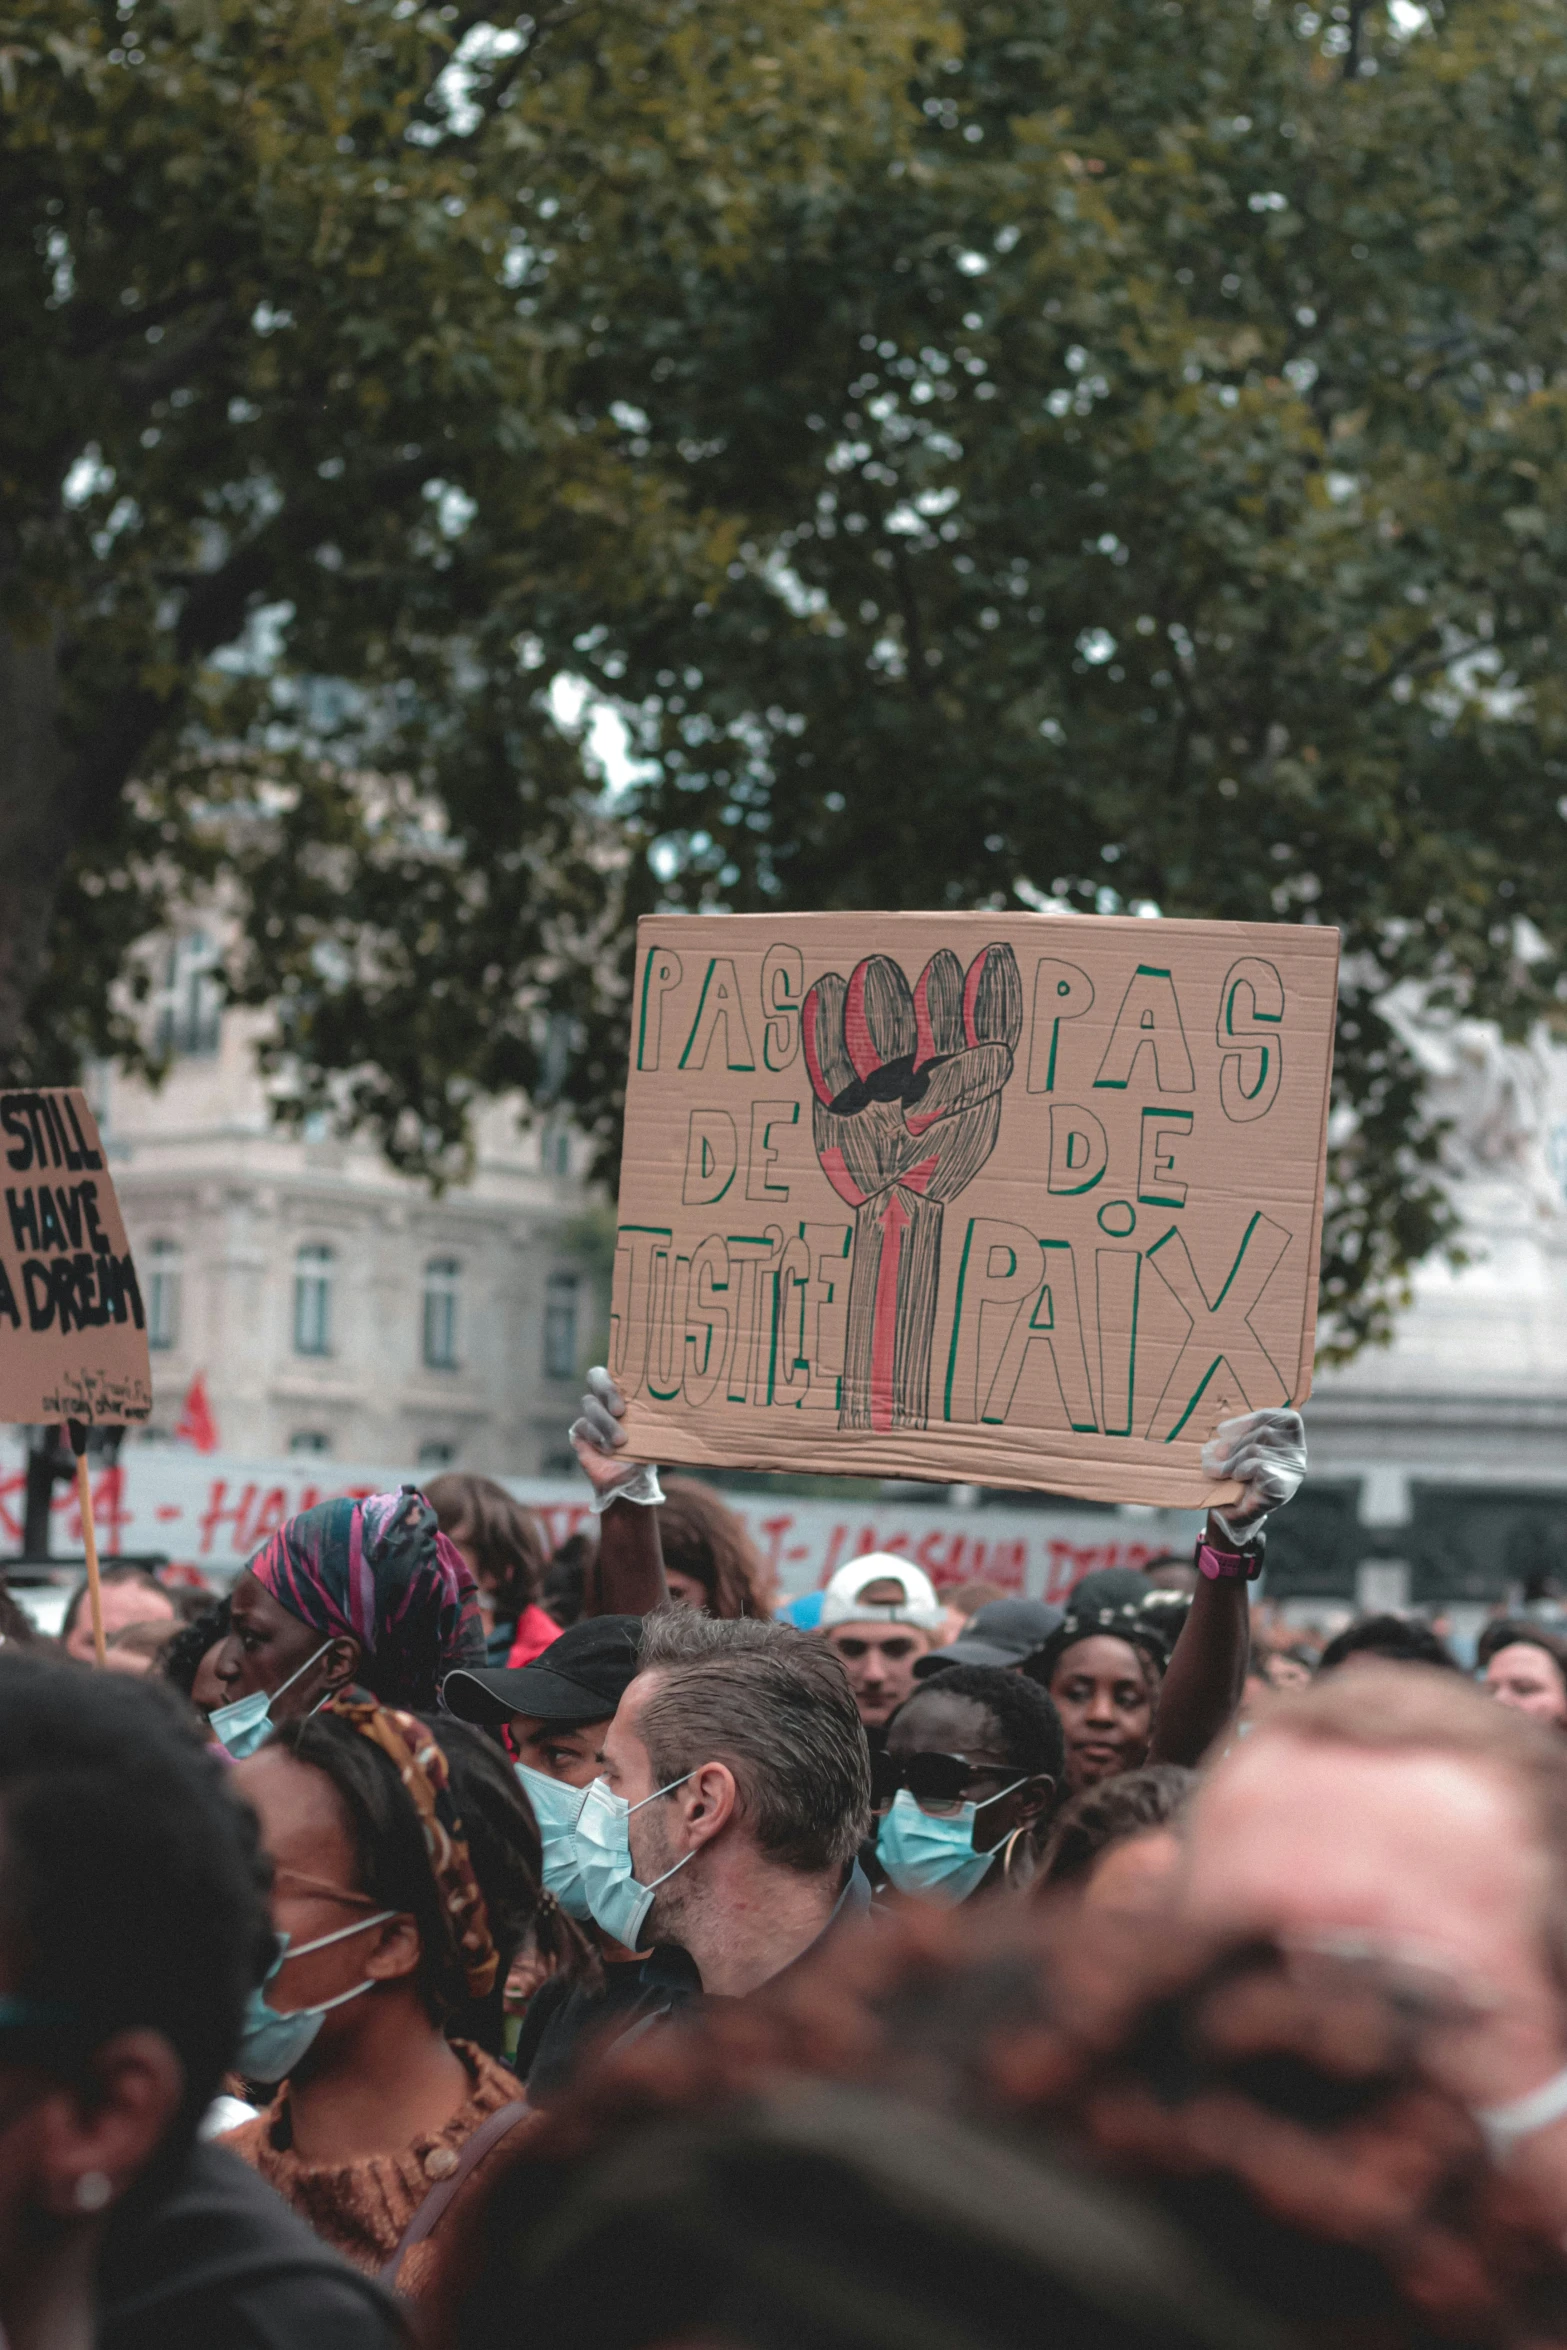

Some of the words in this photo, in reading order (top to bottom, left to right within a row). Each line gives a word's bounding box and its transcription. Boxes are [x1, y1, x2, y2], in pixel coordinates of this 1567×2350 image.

[637, 943, 803, 1072] PAS
[1027, 957, 1285, 1122] PAS
[1, 1093, 103, 1171] STILL
[682, 1100, 800, 1205] DE
[1048, 1103, 1194, 1208] DE
[5, 1180, 110, 1254] HAVE
[22, 1252, 145, 1335] DREAM
[610, 1221, 853, 1410] JUSTICE
